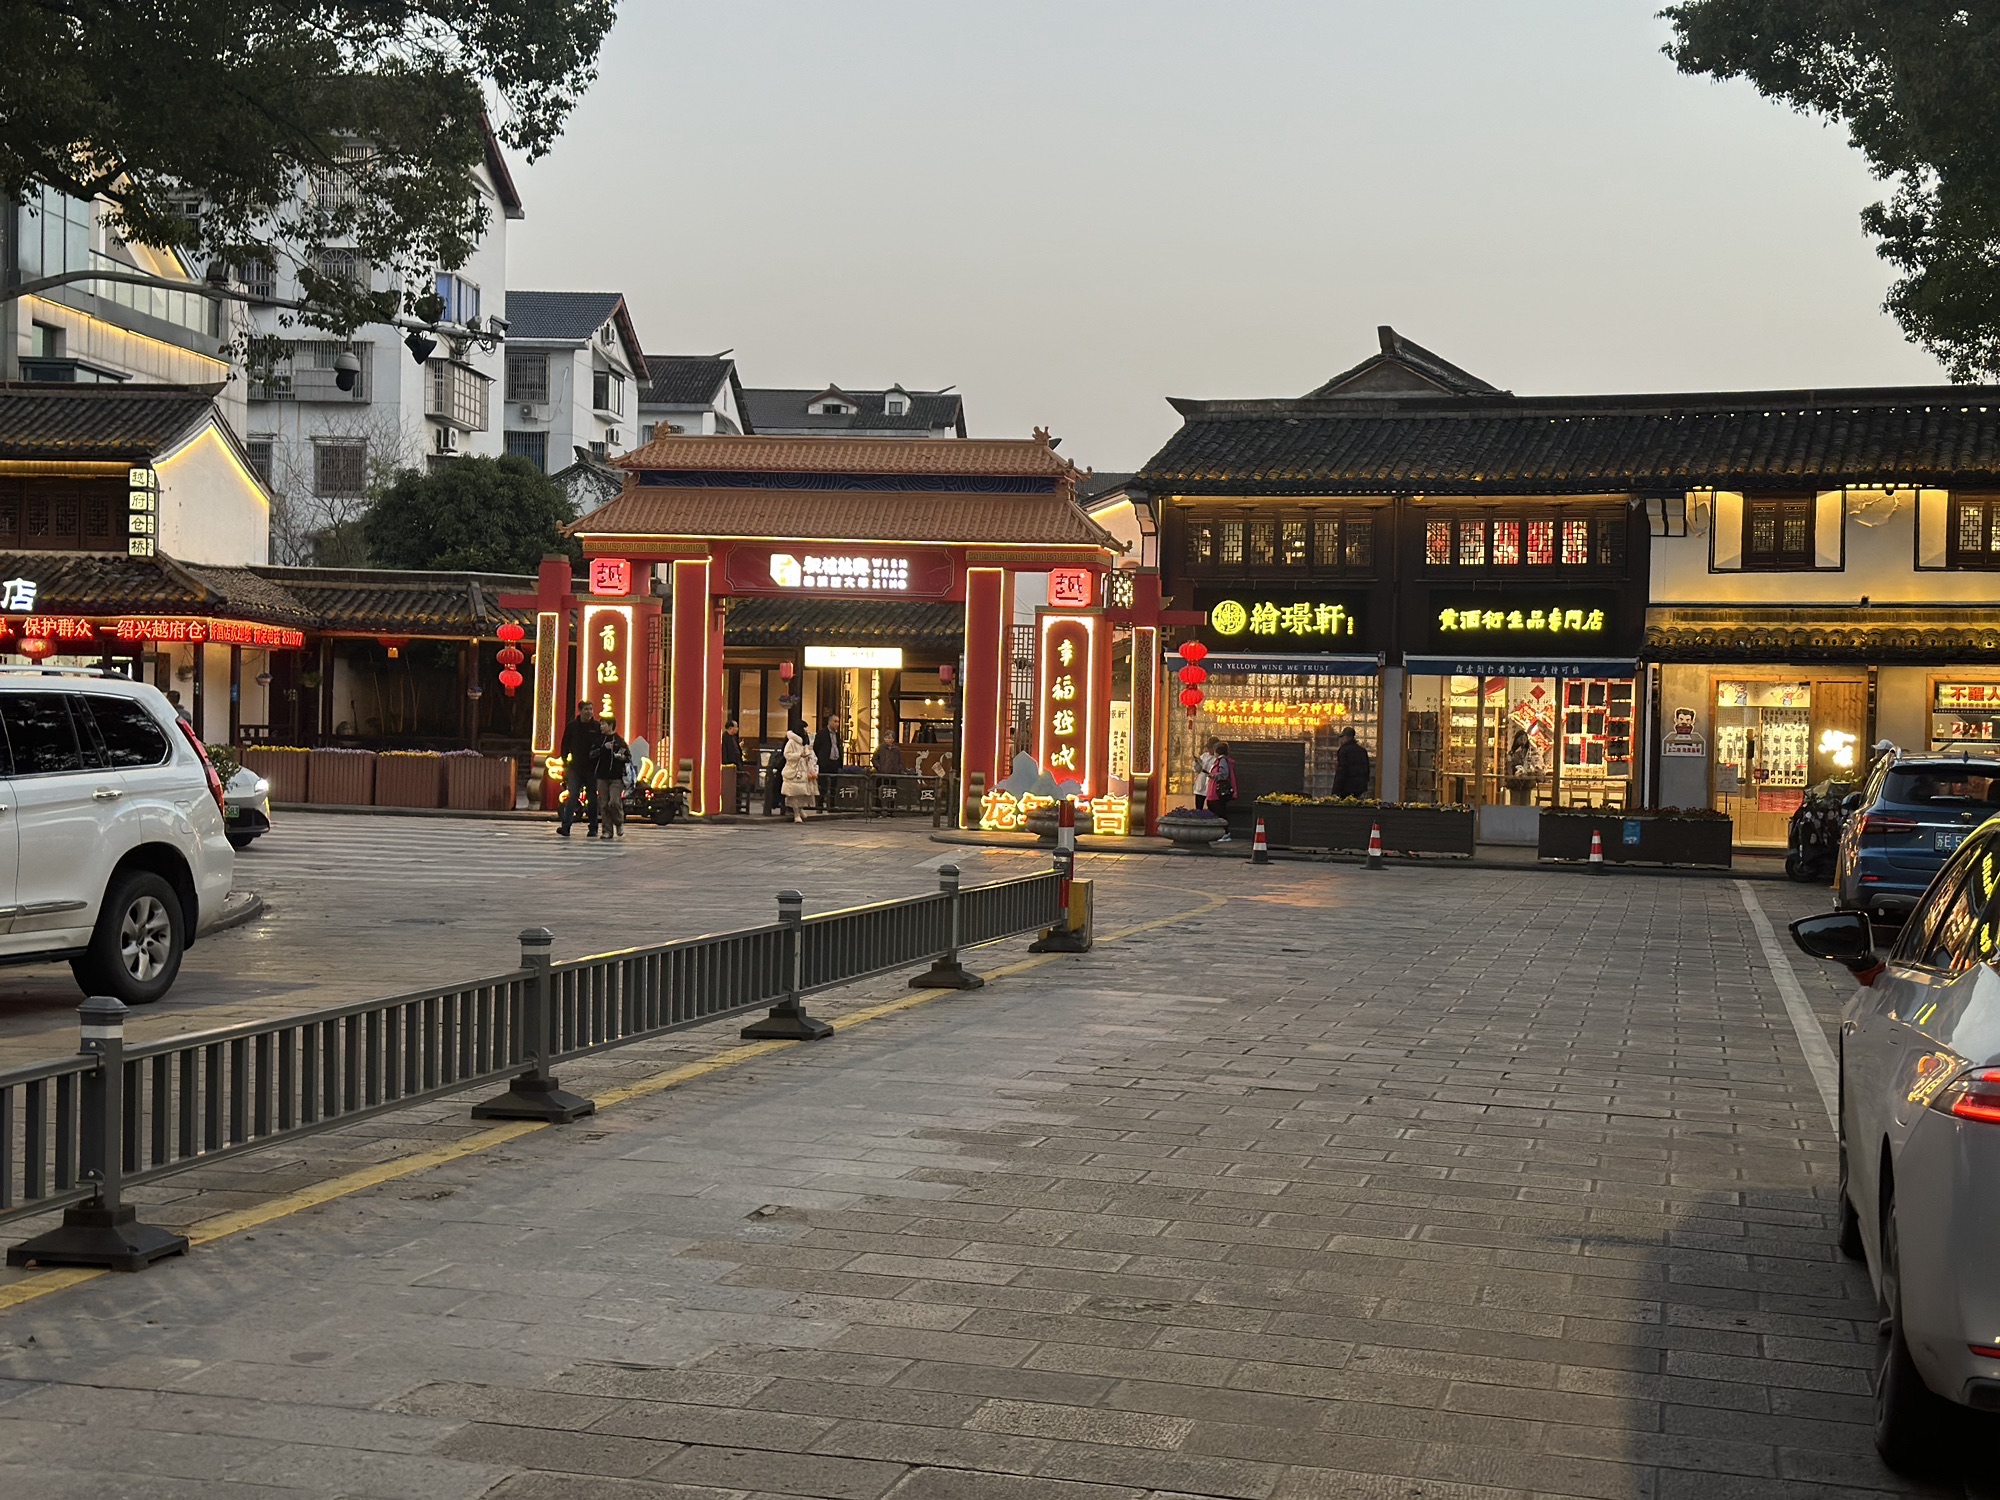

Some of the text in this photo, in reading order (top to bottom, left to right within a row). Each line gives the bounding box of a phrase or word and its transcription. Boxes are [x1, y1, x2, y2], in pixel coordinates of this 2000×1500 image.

[131, 471, 146, 553] 越府仓桥
[596, 562, 627, 591] 越
[1055, 573, 1083, 602] 越
[1, 578, 37, 611] 店
[1213, 662, 1223, 670] IN
[1226, 662, 1258, 670] YELLOW
[1303, 664, 1330, 672] TRUST
[1949, 686, 2000, 702] 不醒人
[1216, 715, 1227, 724] IN
[1229, 715, 1262, 725] YELLOW
[1264, 716, 1285, 726] WINE
[1288, 717, 1300, 726] WE
